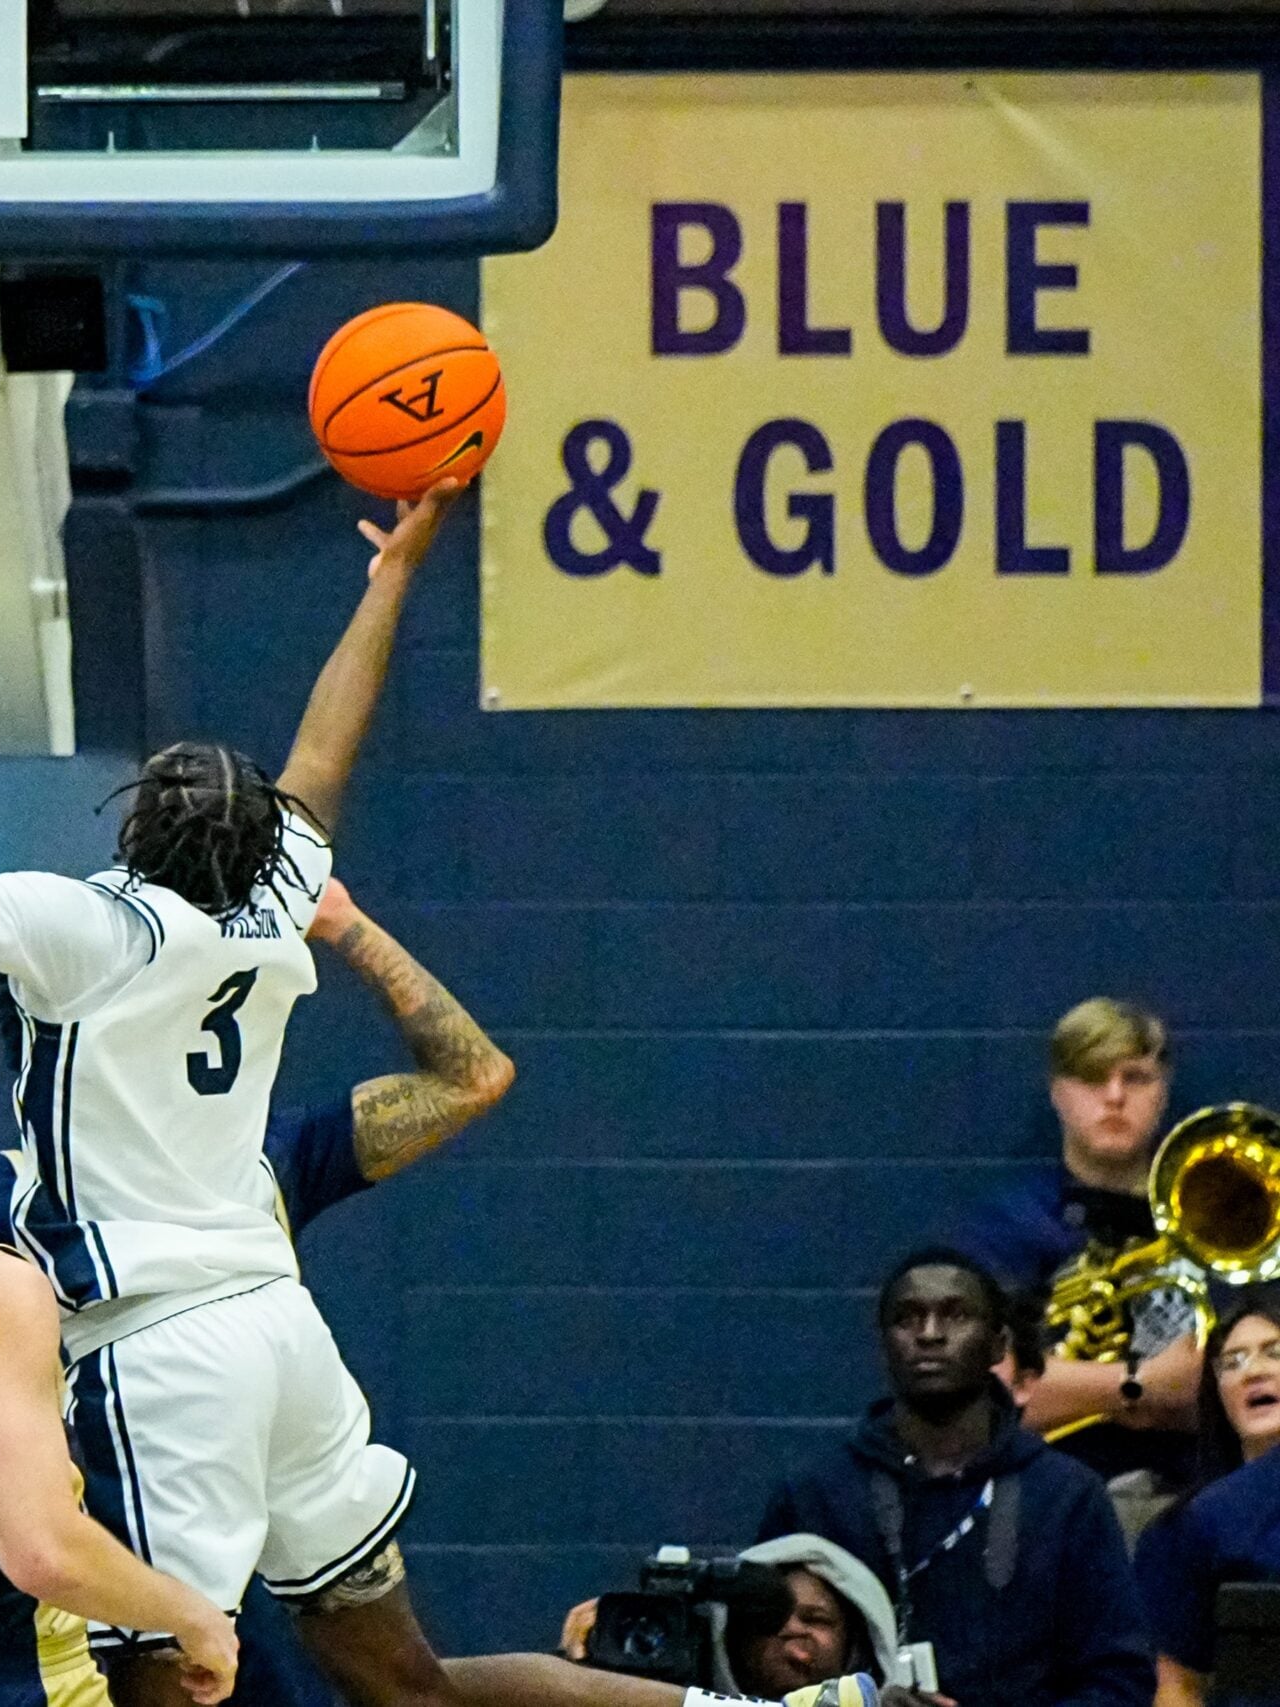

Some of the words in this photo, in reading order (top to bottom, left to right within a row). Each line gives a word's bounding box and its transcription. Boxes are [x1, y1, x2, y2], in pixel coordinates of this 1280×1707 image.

[649, 200, 1092, 357] BLUE
[378, 369, 444, 423] A
[542, 417, 663, 578] &
[732, 416, 1192, 579] GOLD
[186, 966, 260, 1096] 3
